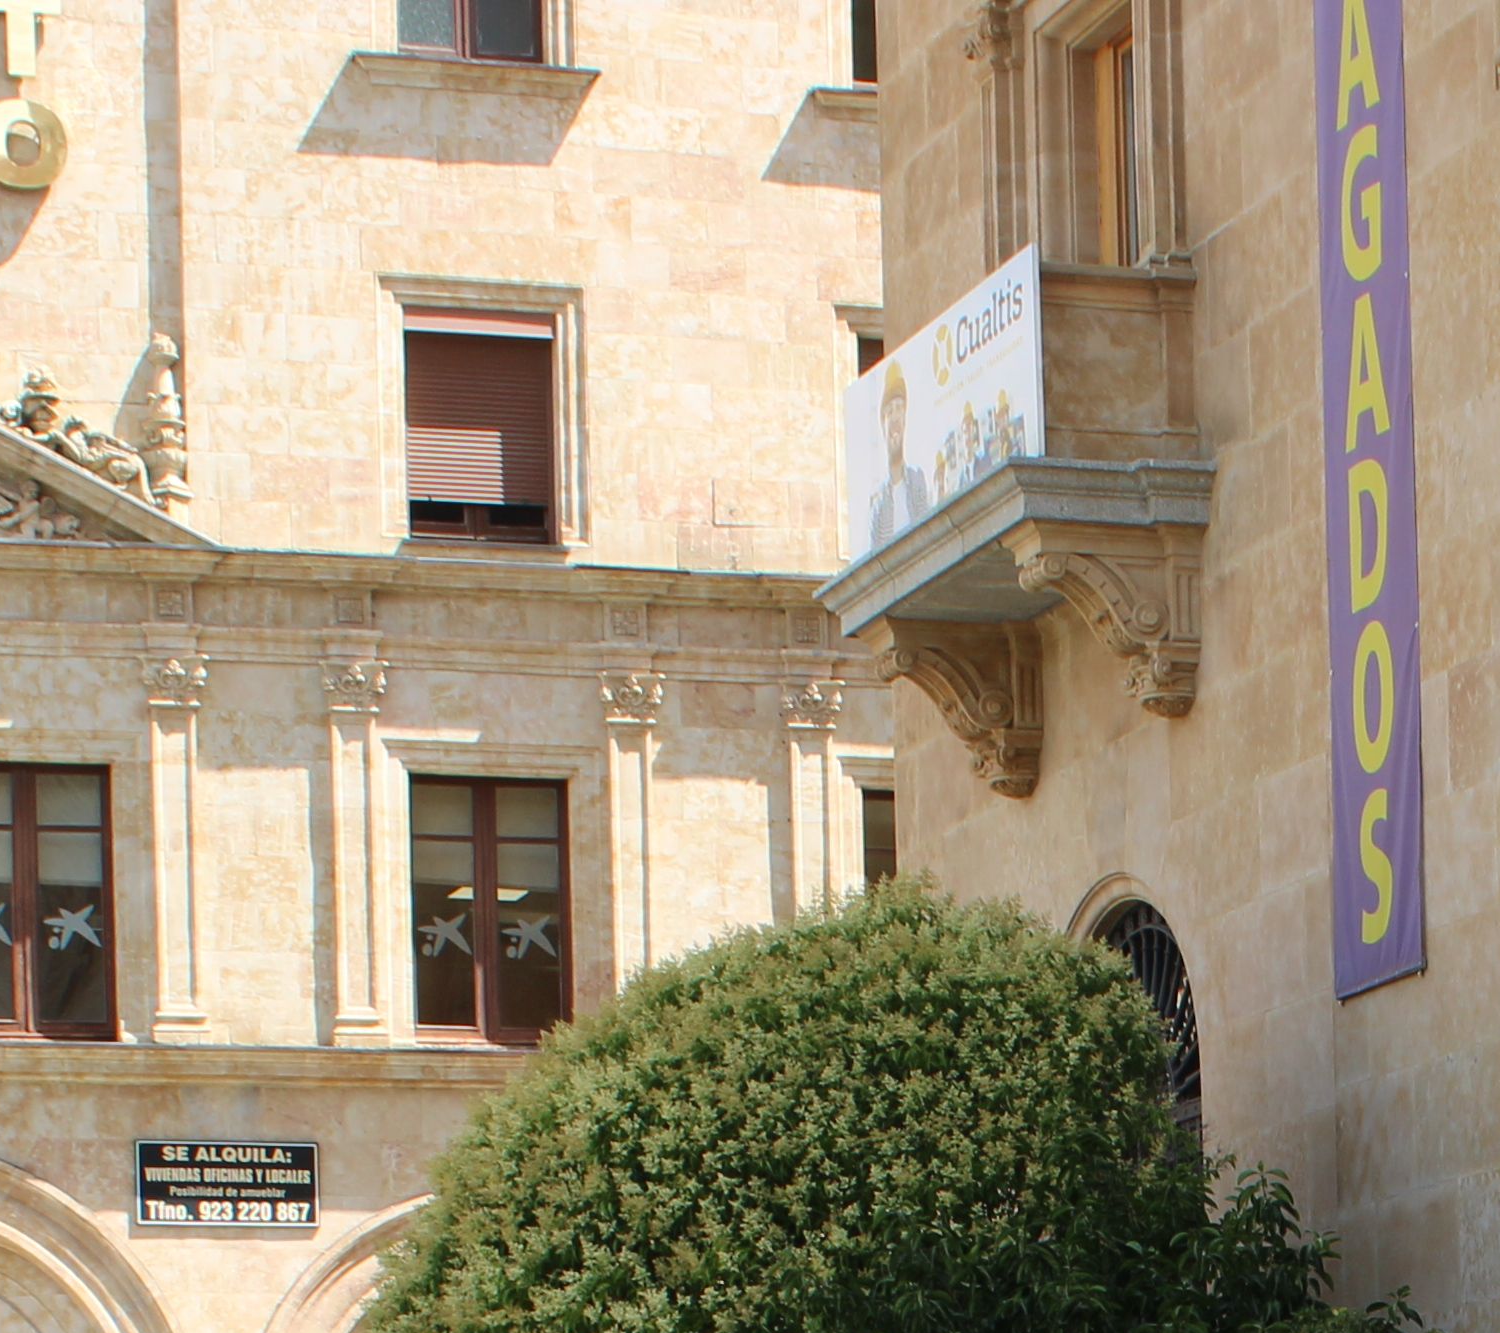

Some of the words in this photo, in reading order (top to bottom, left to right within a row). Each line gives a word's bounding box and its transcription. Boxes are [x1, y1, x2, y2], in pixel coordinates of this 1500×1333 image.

[956, 278, 1023, 364] Cualtis
[162, 1146, 189, 1162] SE
[195, 1147, 292, 1164] ALQUILA:
[144, 1167, 201, 1183] VIVIENDAS
[203, 1168, 253, 1183] OFICINAS
[255, 1169, 264, 1183] Y
[265, 1169, 311, 1184] LOCALES
[169, 1186, 223, 1197] Posibilidad
[225, 1186, 238, 1197] de
[240, 1187, 286, 1198] amueblar
[145, 1200, 194, 1220] Tfno.
[199, 1201, 233, 1221] 923
[237, 1201, 272, 1221] 220
[276, 1202, 311, 1222] 867
